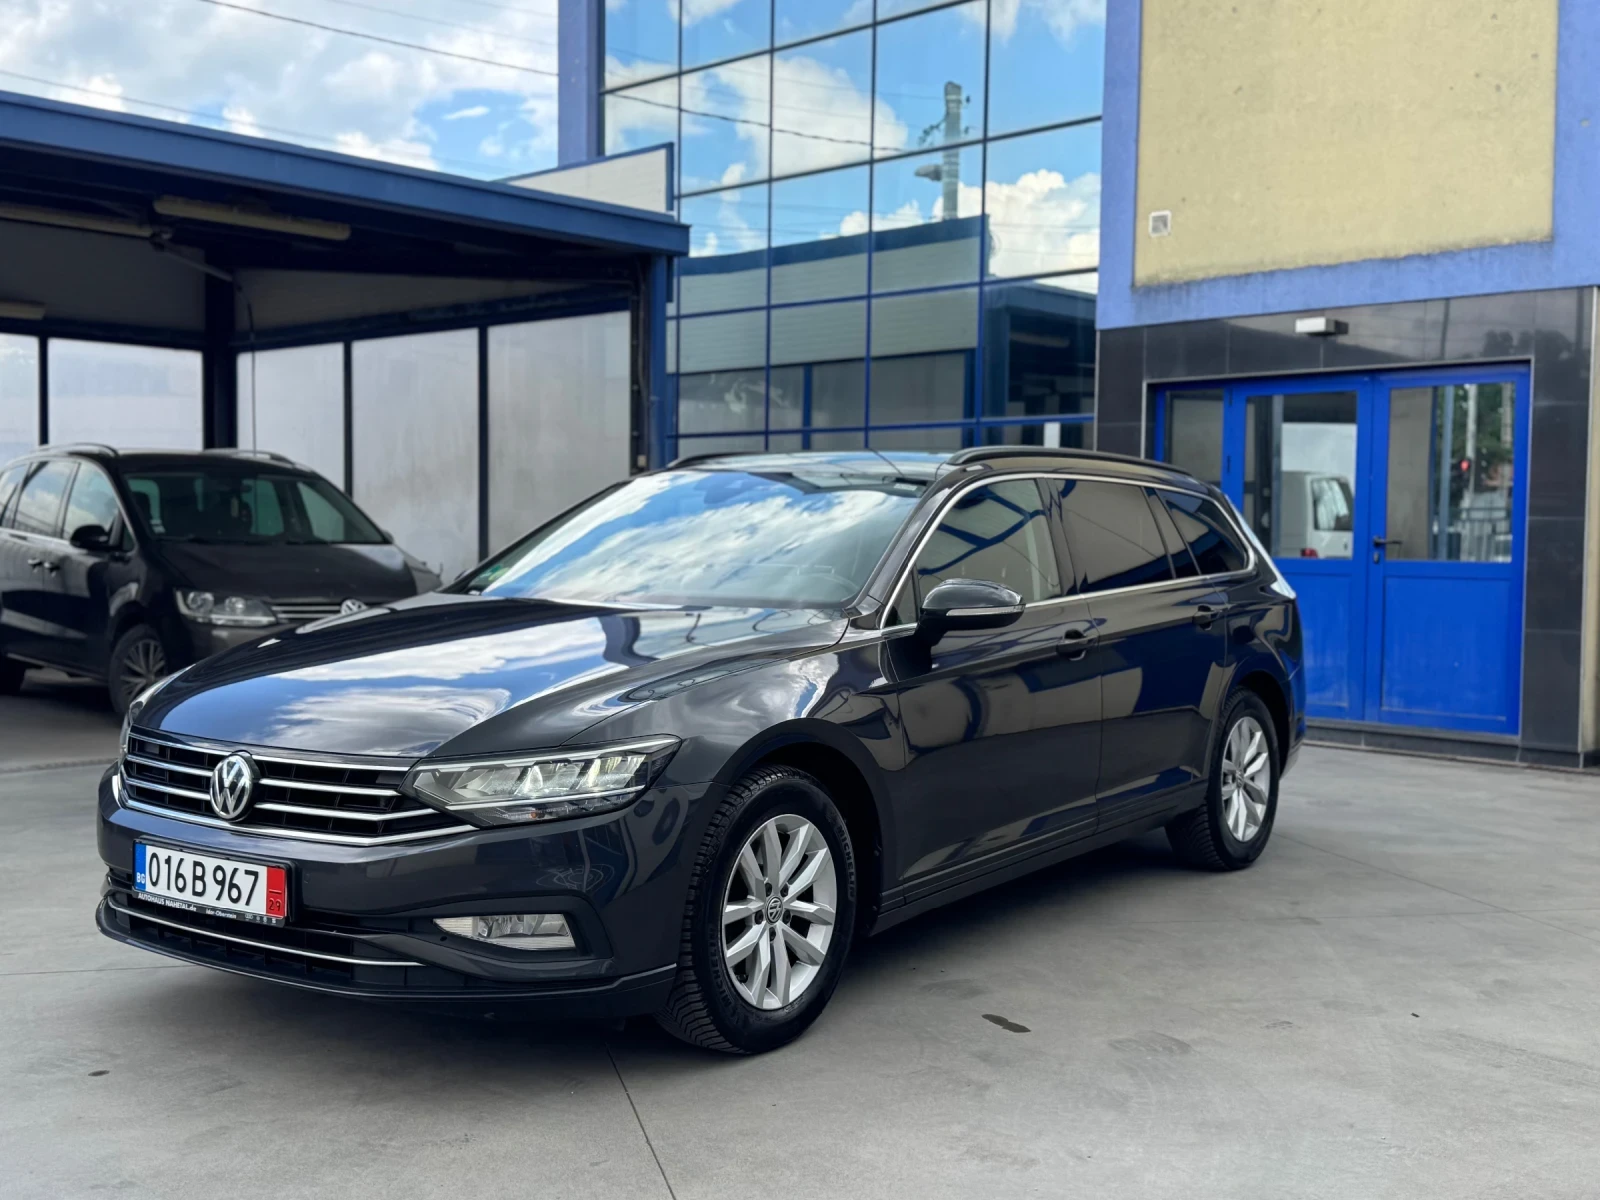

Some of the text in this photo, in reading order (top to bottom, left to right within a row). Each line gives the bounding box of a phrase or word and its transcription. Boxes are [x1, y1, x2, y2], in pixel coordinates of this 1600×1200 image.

[834, 825, 857, 900] MICHELIN
[136, 872, 146, 884] BG
[138, 892, 165, 905] AUTOHAUS
[268, 898, 282, 912] 29
